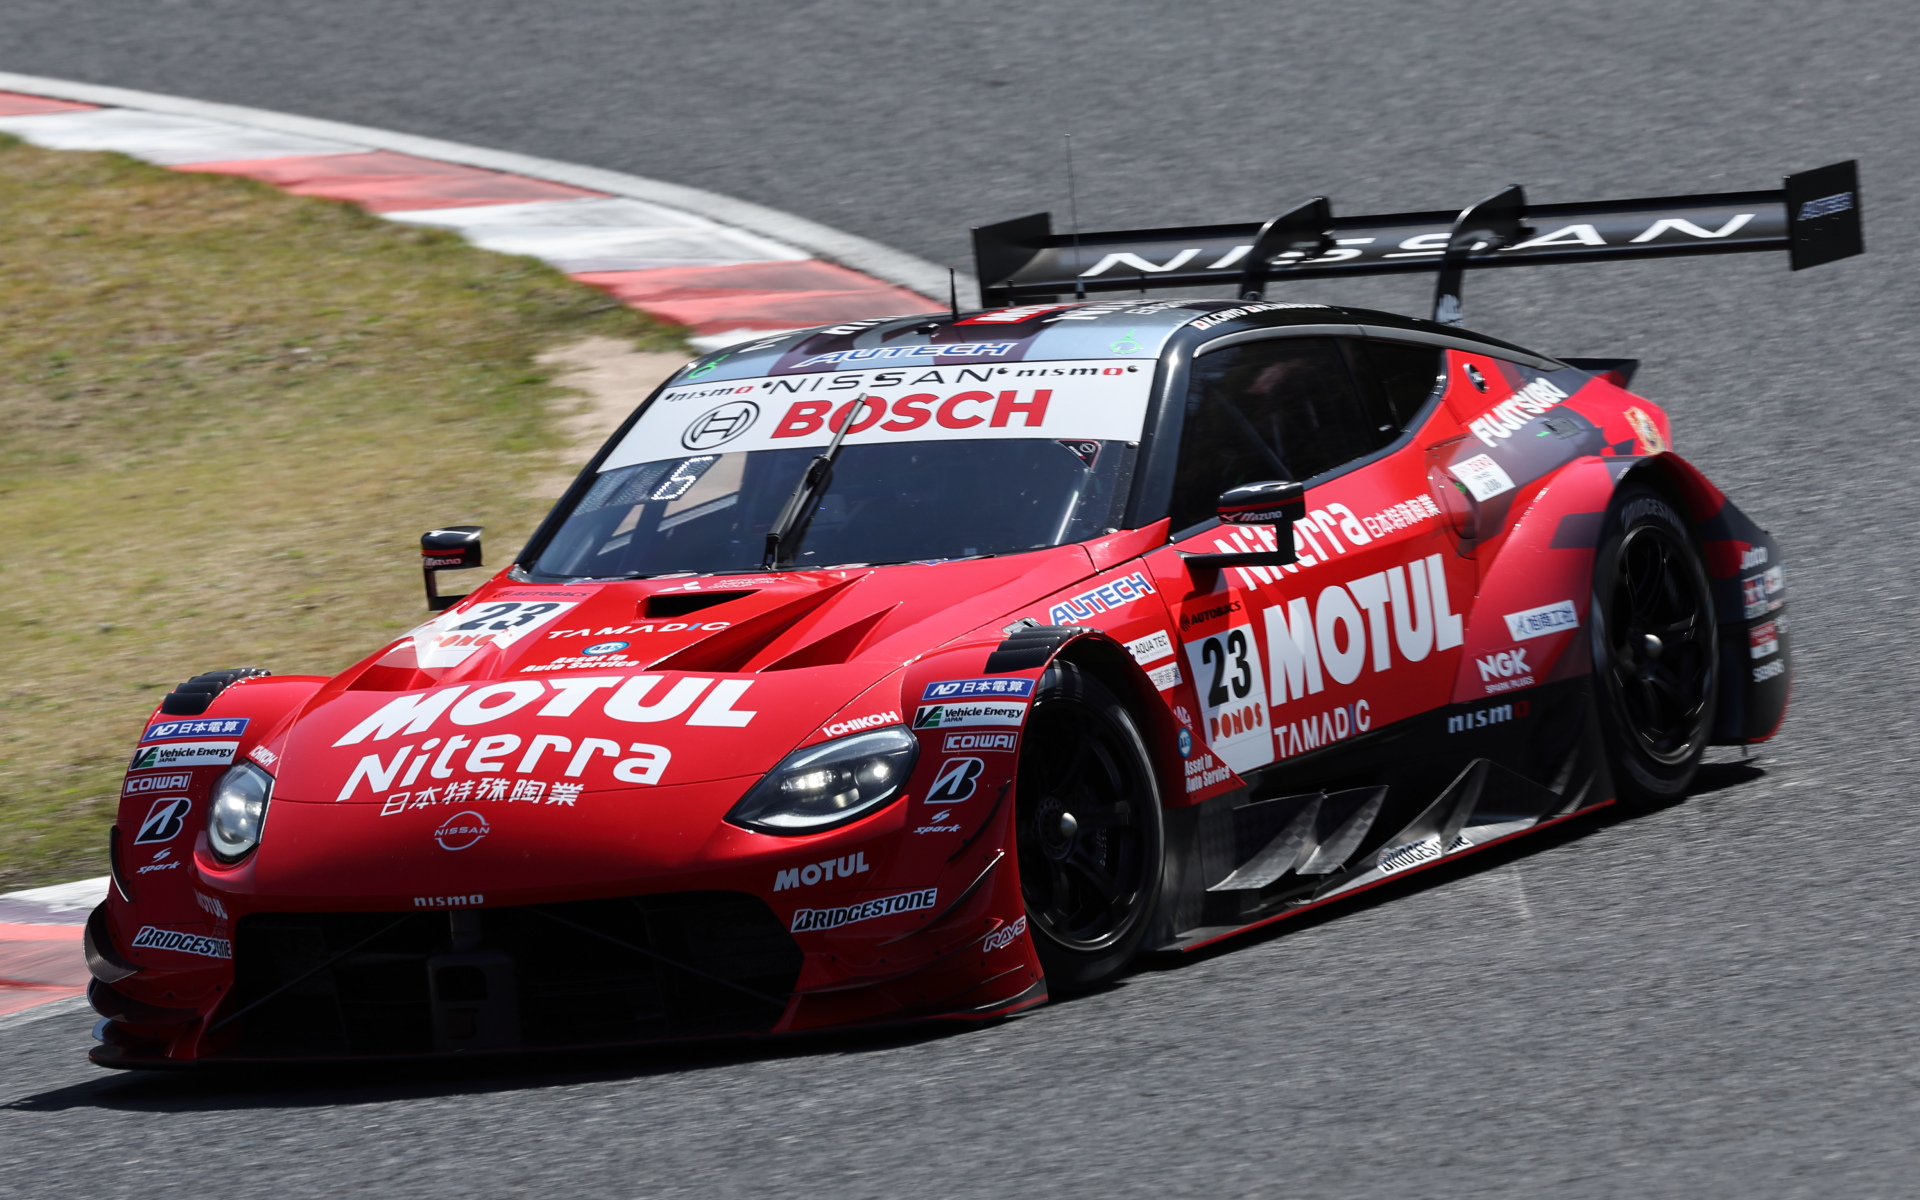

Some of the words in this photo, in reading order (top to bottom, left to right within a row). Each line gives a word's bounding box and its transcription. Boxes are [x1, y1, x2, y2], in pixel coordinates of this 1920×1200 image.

[788, 342, 1018, 369] AUTECH
[767, 367, 995, 395] NISSAN
[1015, 365, 1124, 378] nismo
[670, 385, 755, 402] nismo
[770, 388, 1053, 439] BOSCH
[1049, 571, 1157, 626] AUTECH
[1191, 600, 1242, 626] AUTOBACS
[446, 602, 562, 632] 23
[547, 621, 732, 639] TAMADIC
[1262, 552, 1464, 708] MOTUL
[1201, 629, 1252, 708] 23
[1475, 647, 1532, 682] NGK
[962, 680, 1026, 694] 日本電算
[331, 675, 758, 748] MOTUL
[822, 710, 900, 738] ICHIKOH
[945, 706, 983, 718] Vehicle
[983, 707, 1024, 720] Energy
[1209, 701, 1263, 742] PONOS
[1448, 700, 1530, 734] nismo
[178, 720, 240, 734] 日本電算
[1273, 699, 1371, 759] TAMADIC
[160, 747, 195, 758] Vehicle
[196, 746, 235, 759] Energy
[249, 744, 278, 768] ICHIKOH
[334, 734, 673, 803] Niterra
[380, 777, 585, 817] 日本特殊陶業
[433, 825, 491, 838] NISSAN
[912, 823, 962, 835] spark
[136, 860, 181, 875] spark
[773, 851, 870, 892] MOTUL
[413, 894, 484, 907] nismo
[790, 887, 938, 933] BRIDGESTONE
[132, 925, 233, 959] BRIDGESTONE
[982, 915, 1026, 952] RAYS
